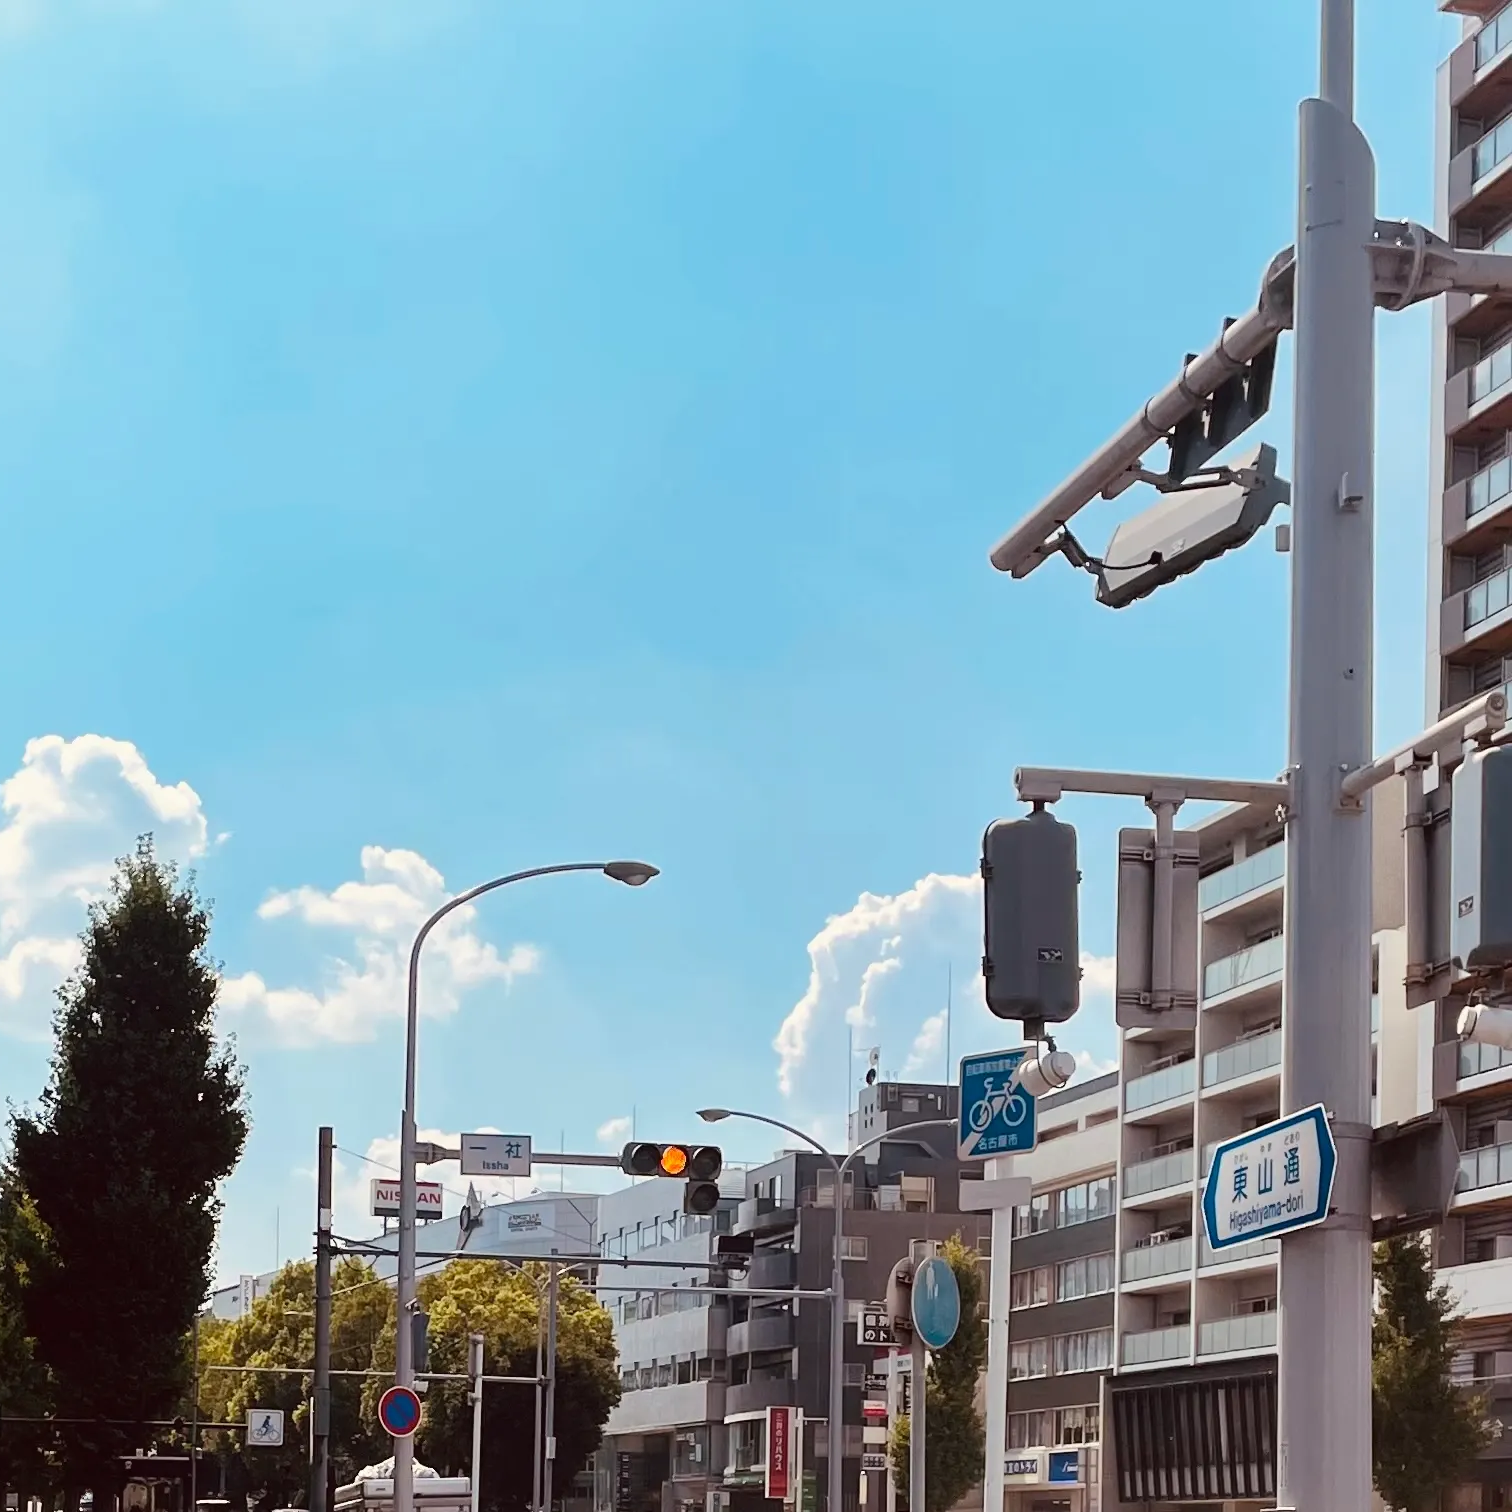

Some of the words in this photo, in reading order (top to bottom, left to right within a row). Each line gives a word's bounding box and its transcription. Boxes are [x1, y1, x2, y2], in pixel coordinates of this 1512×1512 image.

[468, 1141, 523, 1159] 一社
[977, 1134, 1019, 1151] 名古屋市
[482, 1160, 510, 1171] Issha
[1232, 1147, 1301, 1204] 東山通
[376, 1189, 441, 1204] NISAN
[1229, 1189, 1304, 1233] Higashiyama-dori
